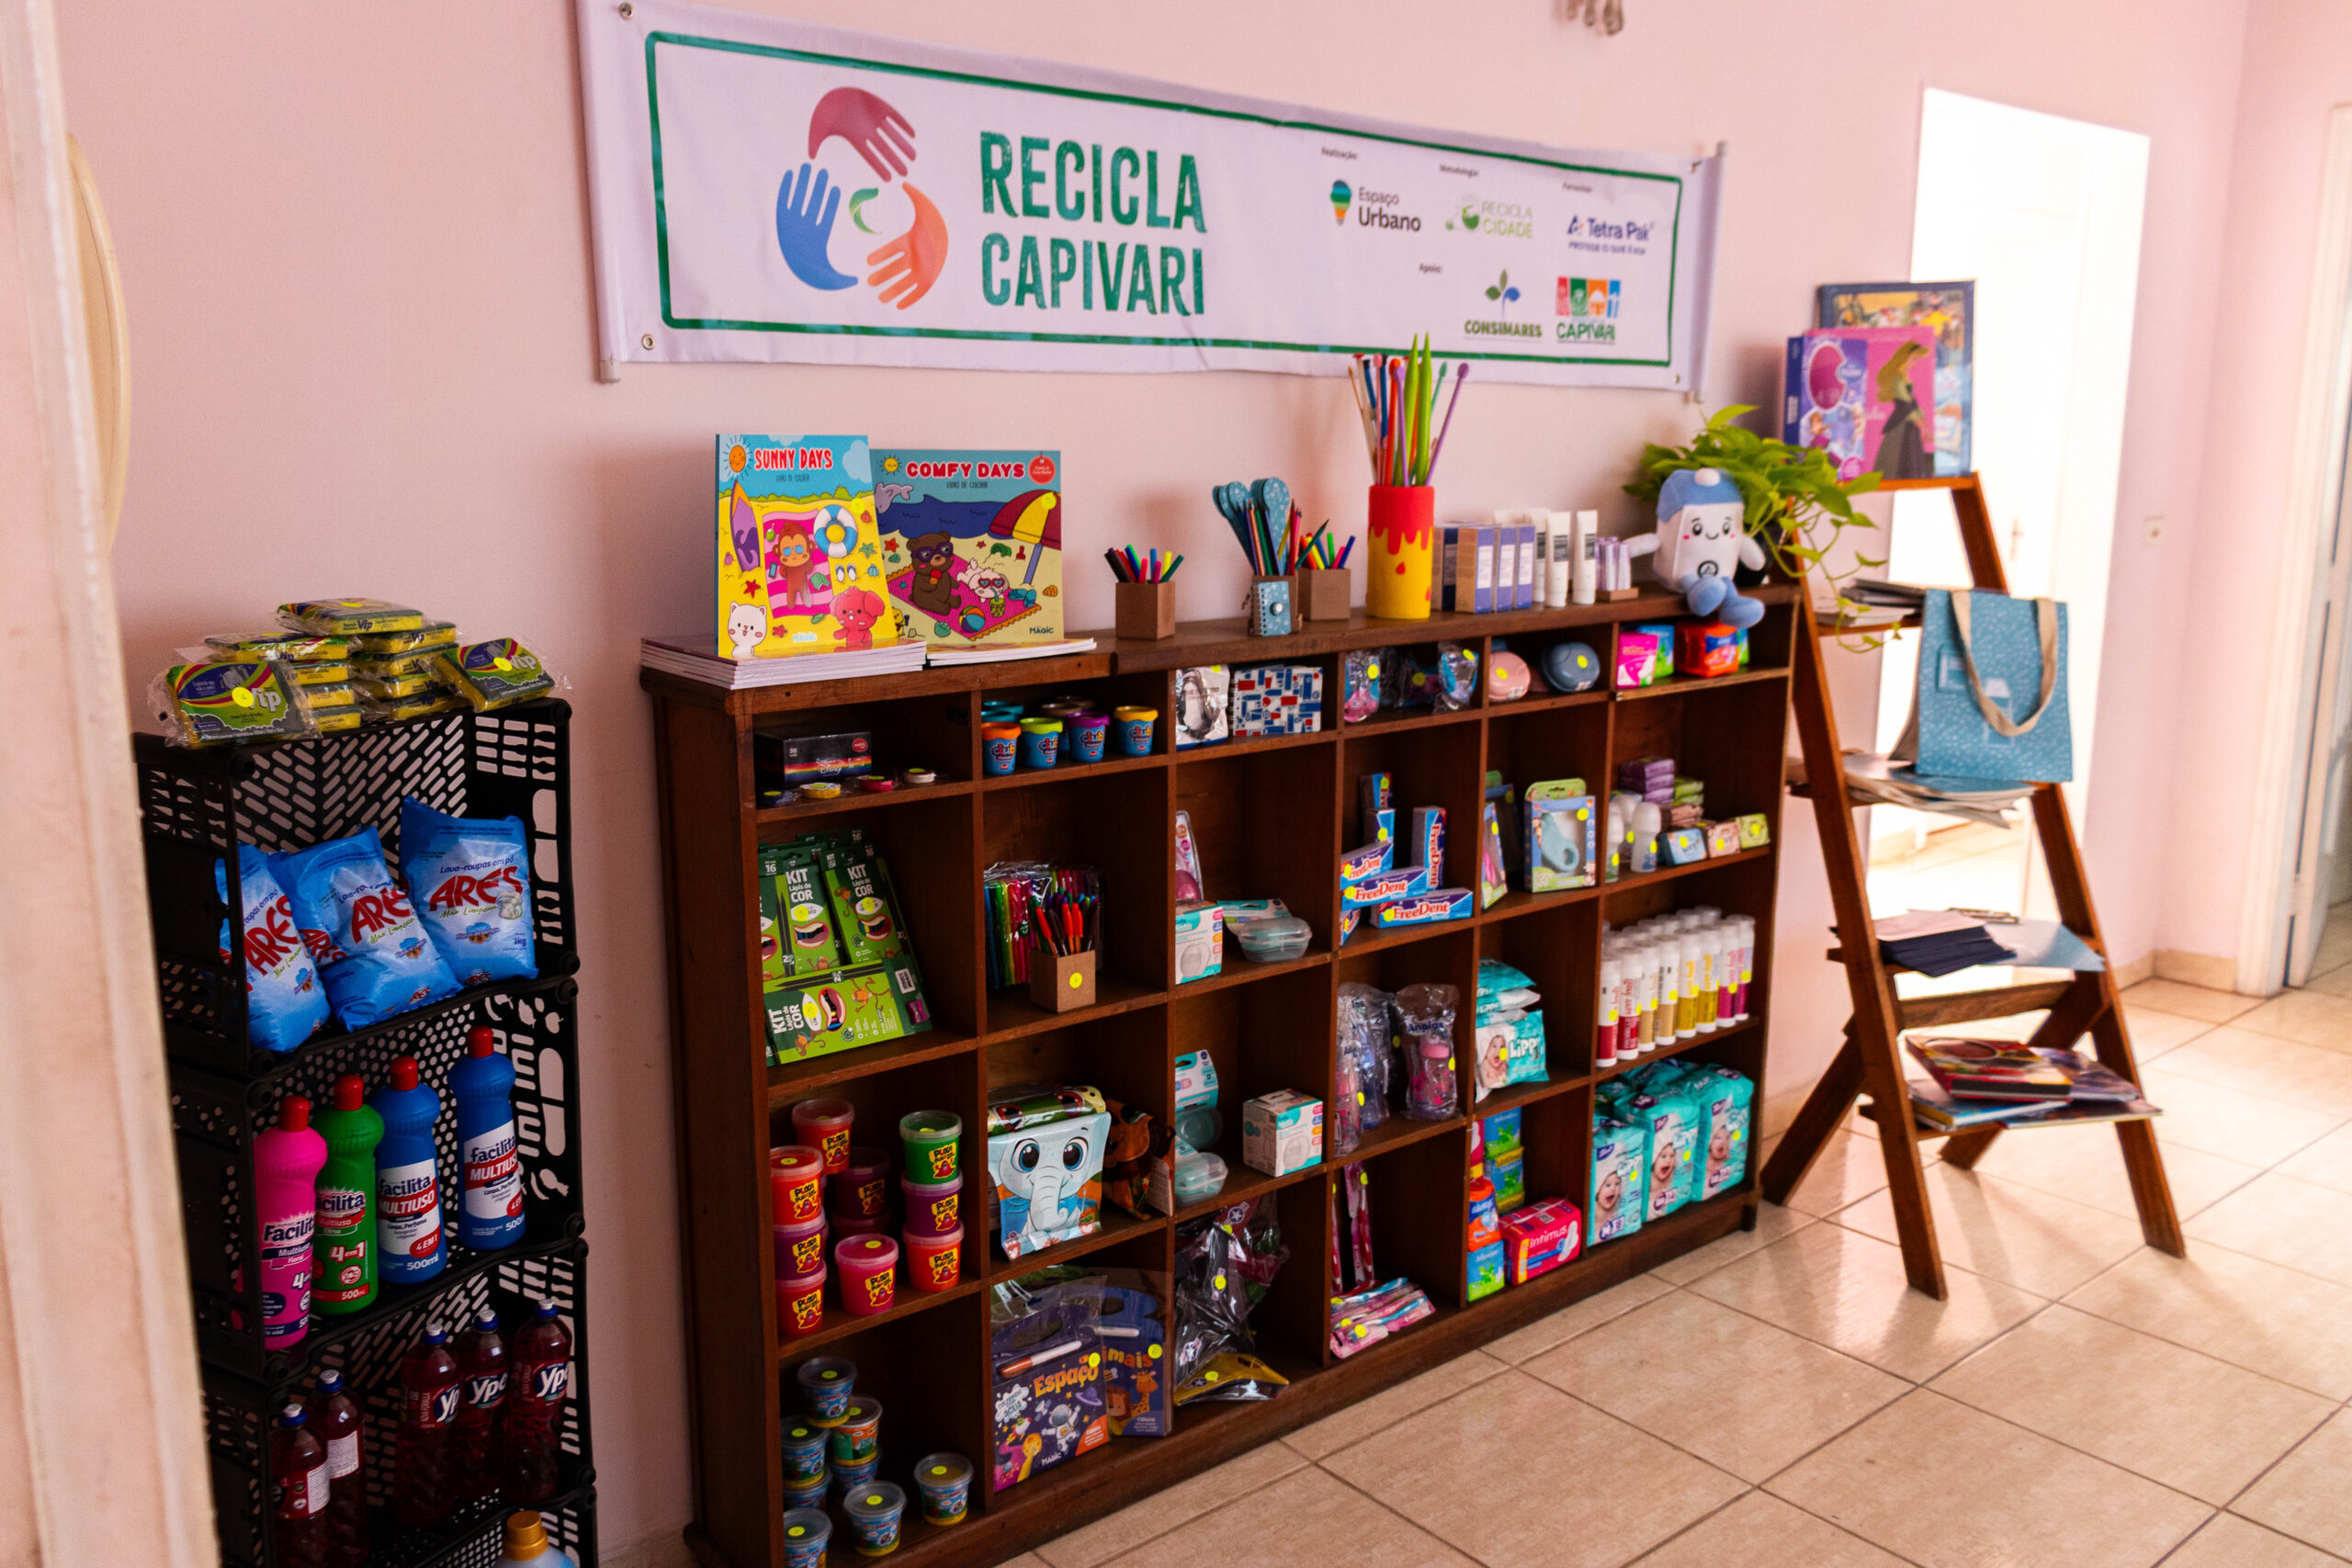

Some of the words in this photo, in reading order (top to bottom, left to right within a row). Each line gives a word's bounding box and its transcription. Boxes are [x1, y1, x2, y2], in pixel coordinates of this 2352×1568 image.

[980, 130, 1207, 233] RECICLA
[1359, 186, 1399, 207] Espaço
[1359, 207, 1421, 231] Urbano
[1482, 200, 1532, 220] RECICLA
[1482, 218, 1533, 239] CIDADE
[1587, 218, 1623, 240] Tetra
[981, 232, 1204, 316] CAPIVARI
[1464, 320, 1543, 338] CONSIMARES
[1556, 321, 1615, 341] CAPIVARI
[754, 447, 796, 470] SUNNY
[799, 447, 833, 470] DAYS
[906, 461, 973, 479] COMFY
[977, 462, 1025, 479] DAYS
[357, 619, 373, 632] Vip
[1080, 730, 1103, 743] club
[1128, 726, 1151, 738] club
[990, 743, 1015, 756] club
[1430, 824, 1442, 886] FreeDent
[440, 862, 492, 874] Lava-roupas
[492, 858, 504, 866] em
[764, 863, 777, 874] 16
[847, 864, 866, 880] KIT
[785, 868, 808, 885] KIT
[429, 865, 523, 912] ARES
[788, 884, 804, 892] Lápis
[790, 889, 814, 903] COR
[854, 885, 874, 897] COR
[1354, 881, 1408, 901] FreeDent
[1393, 901, 1450, 920] FreeDent
[514, 936, 526, 947] 1kg
[768, 1009, 787, 1034] KIT
[789, 1003, 805, 1030] COR
[379, 1175, 432, 1197] facilita
[378, 1189, 435, 1215] MULTIUSO
[1529, 1224, 1567, 1249] intimus
[406, 1253, 439, 1271] 500ml
[1033, 1365, 1099, 1398] Espaço
